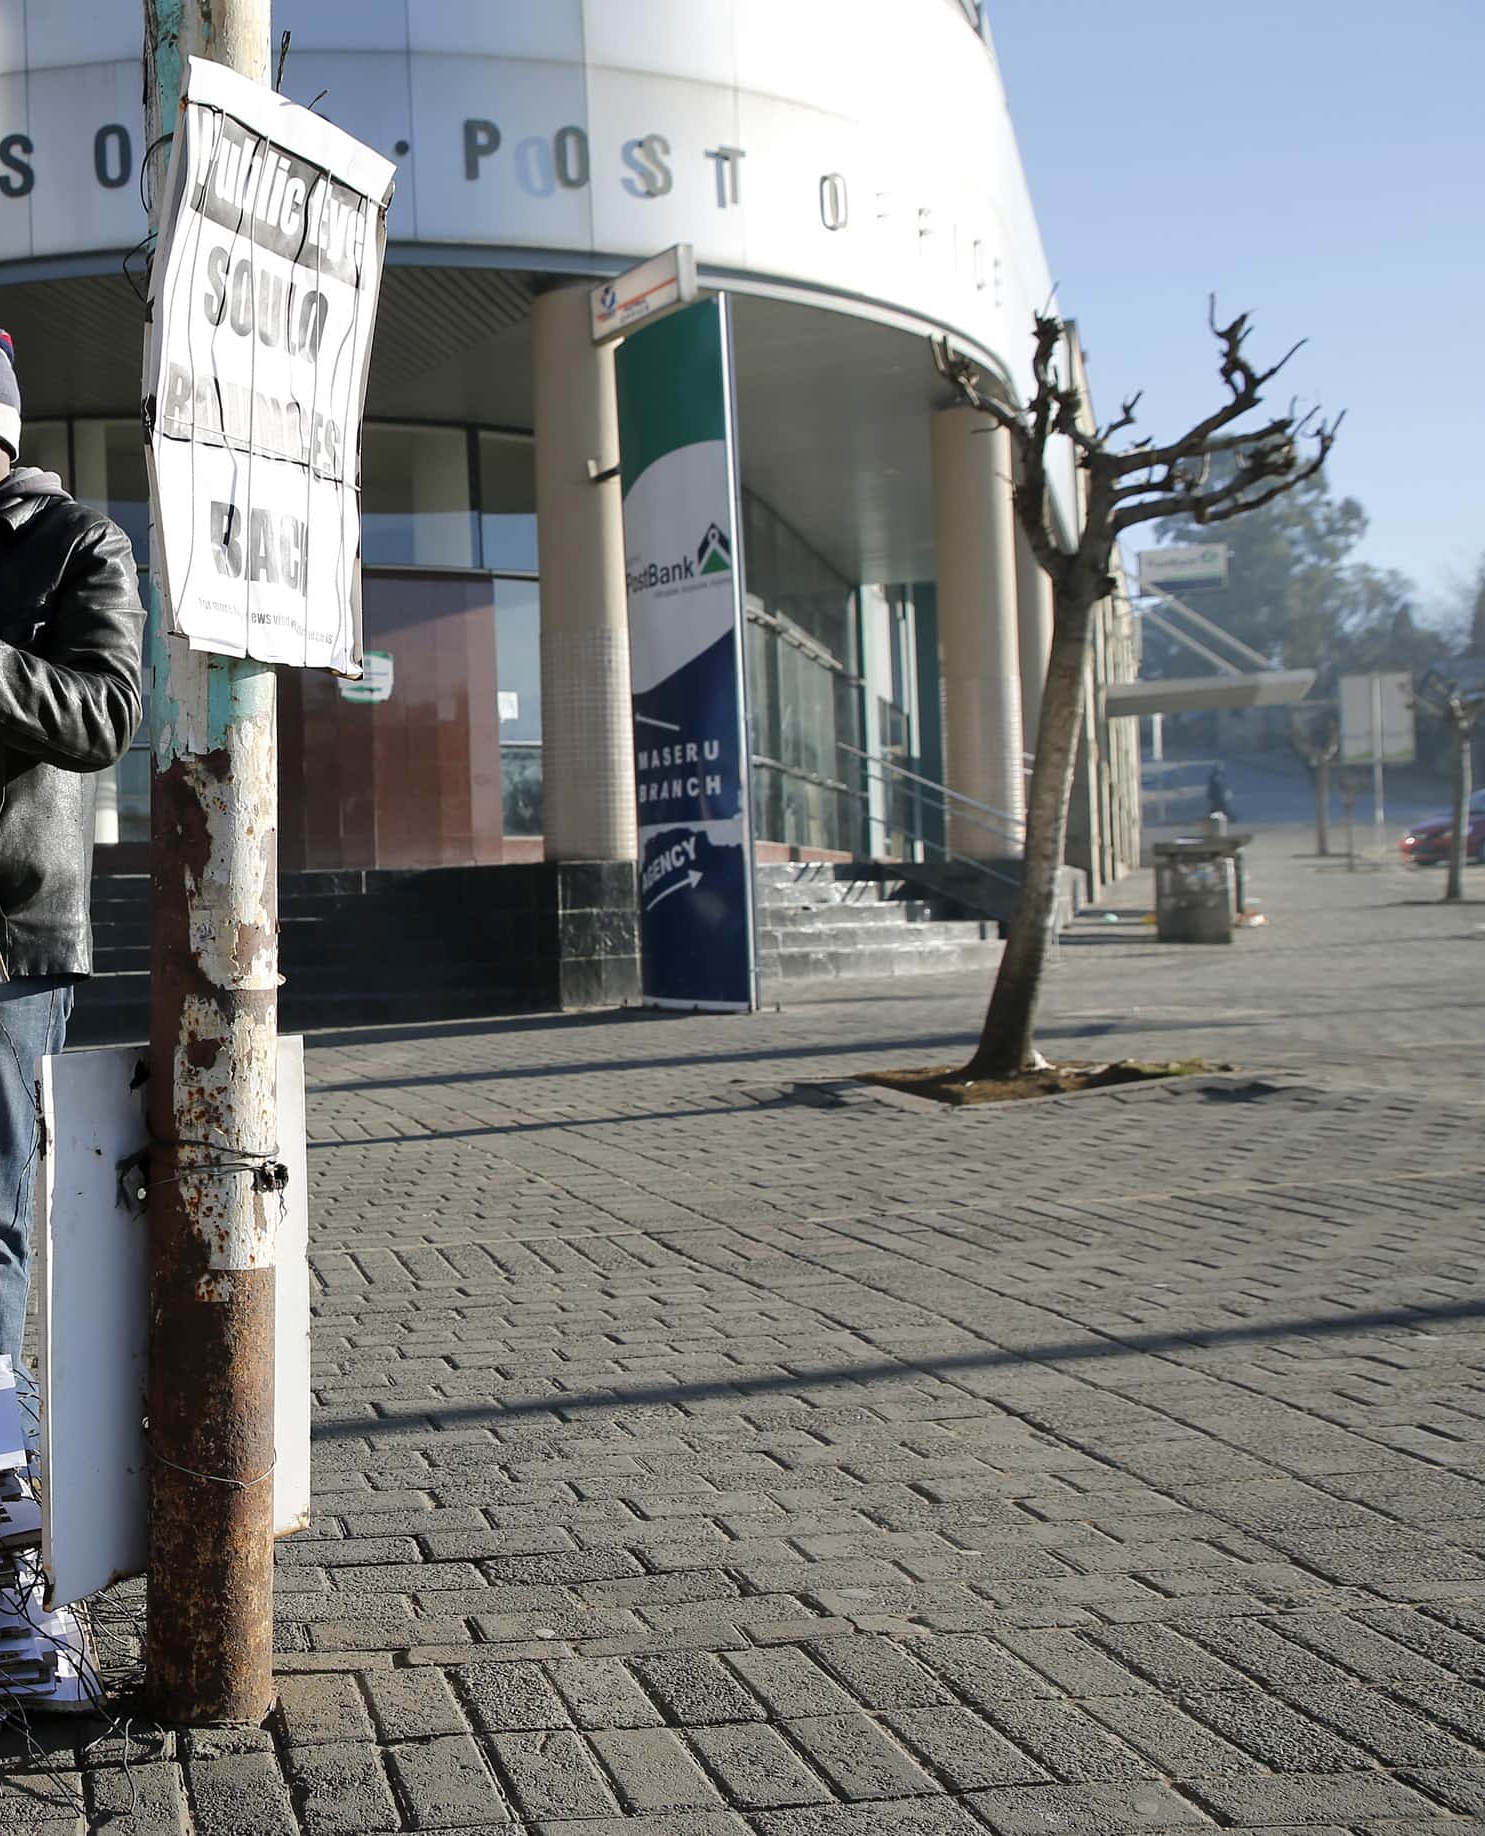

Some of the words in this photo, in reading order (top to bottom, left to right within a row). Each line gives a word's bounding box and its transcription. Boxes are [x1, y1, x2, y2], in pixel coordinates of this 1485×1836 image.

[463, 117, 746, 208] POST
[210, 500, 309, 598] BAC
[637, 739, 720, 771] MASERU
[639, 774, 722, 803] BRANCH
